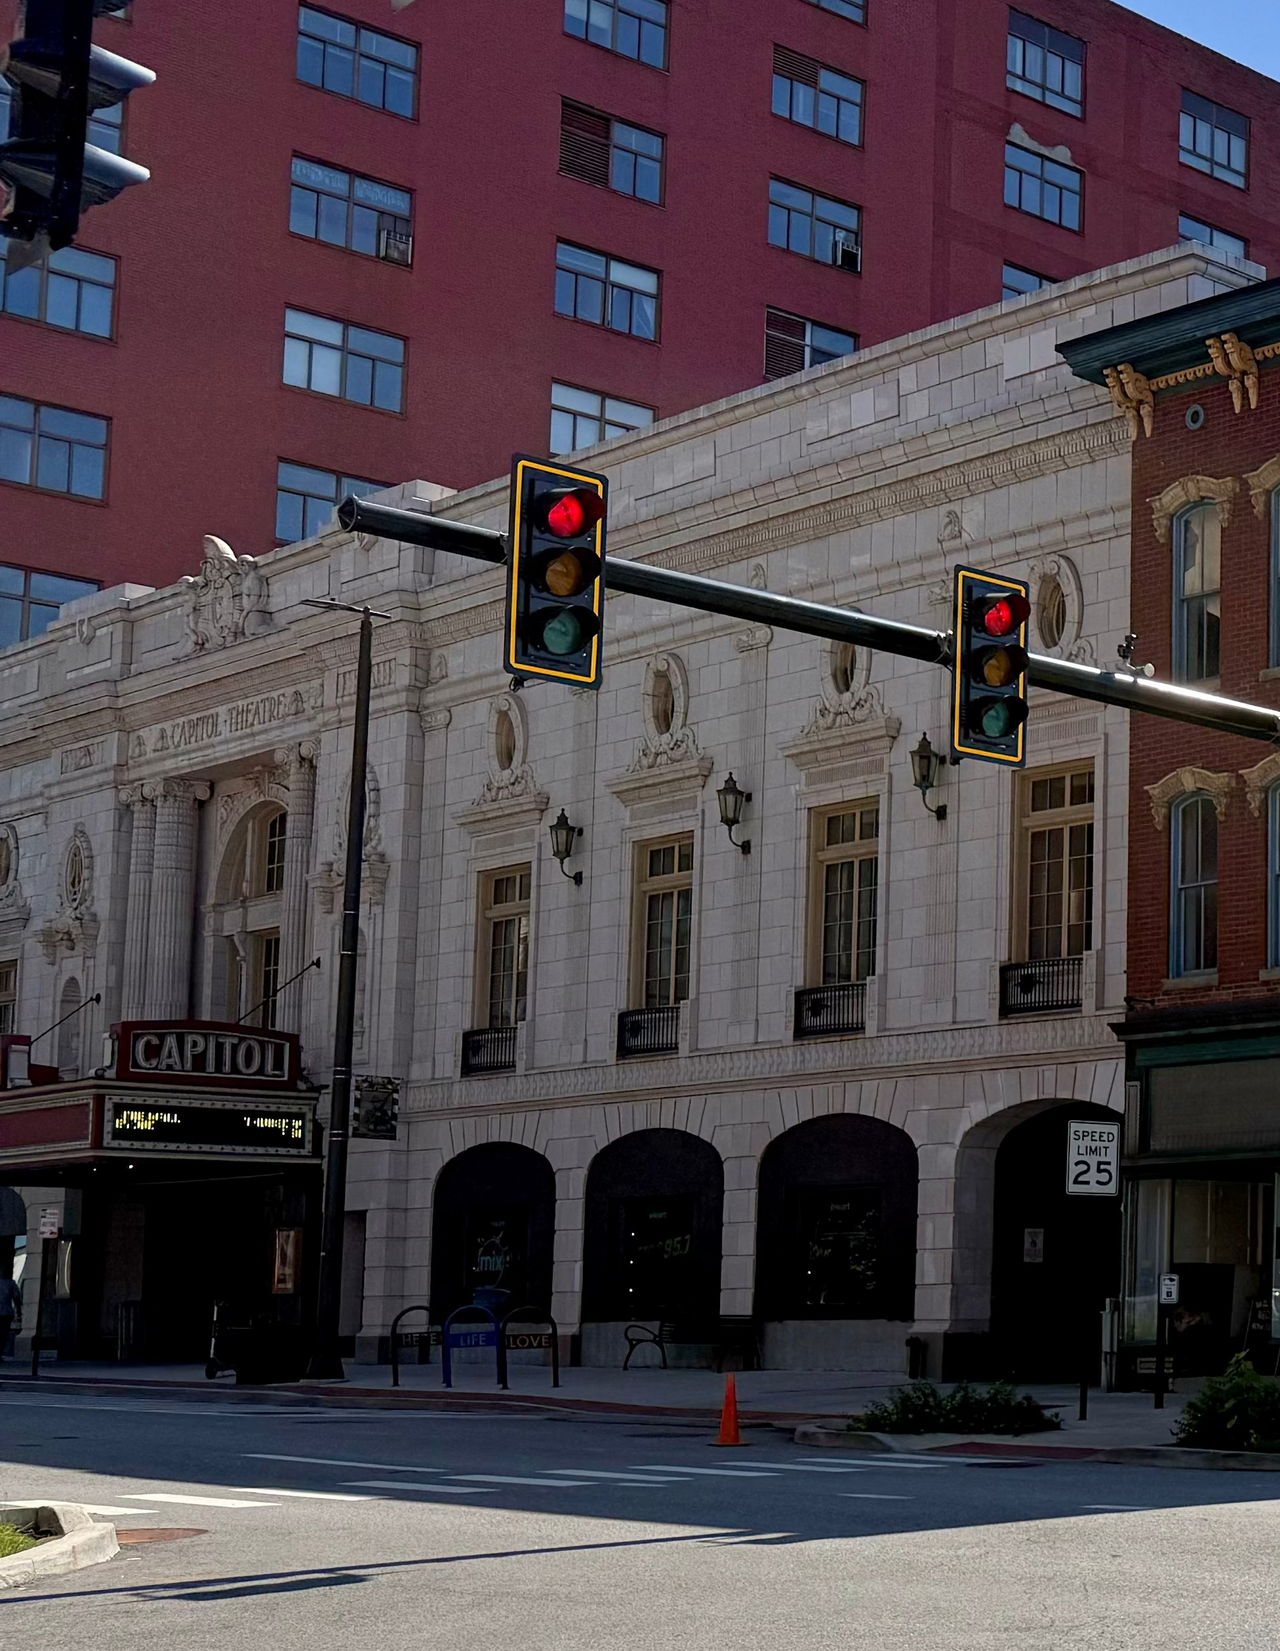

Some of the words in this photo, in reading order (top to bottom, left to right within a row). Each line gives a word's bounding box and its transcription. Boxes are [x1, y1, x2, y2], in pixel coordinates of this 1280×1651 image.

[171, 711, 222, 749] CAPITOL
[228, 693, 286, 733] THEATRE
[135, 1033, 284, 1076] CAPITOL
[1073, 1130, 1115, 1142] SPEED
[1077, 1145, 1110, 1157] LIMIT
[1072, 1160, 1113, 1186] 25
[478, 1250, 505, 1271] mix
[402, 1332, 437, 1346] HEE
[460, 1333, 487, 1346] LIFE
[510, 1335, 550, 1348] LOVE
